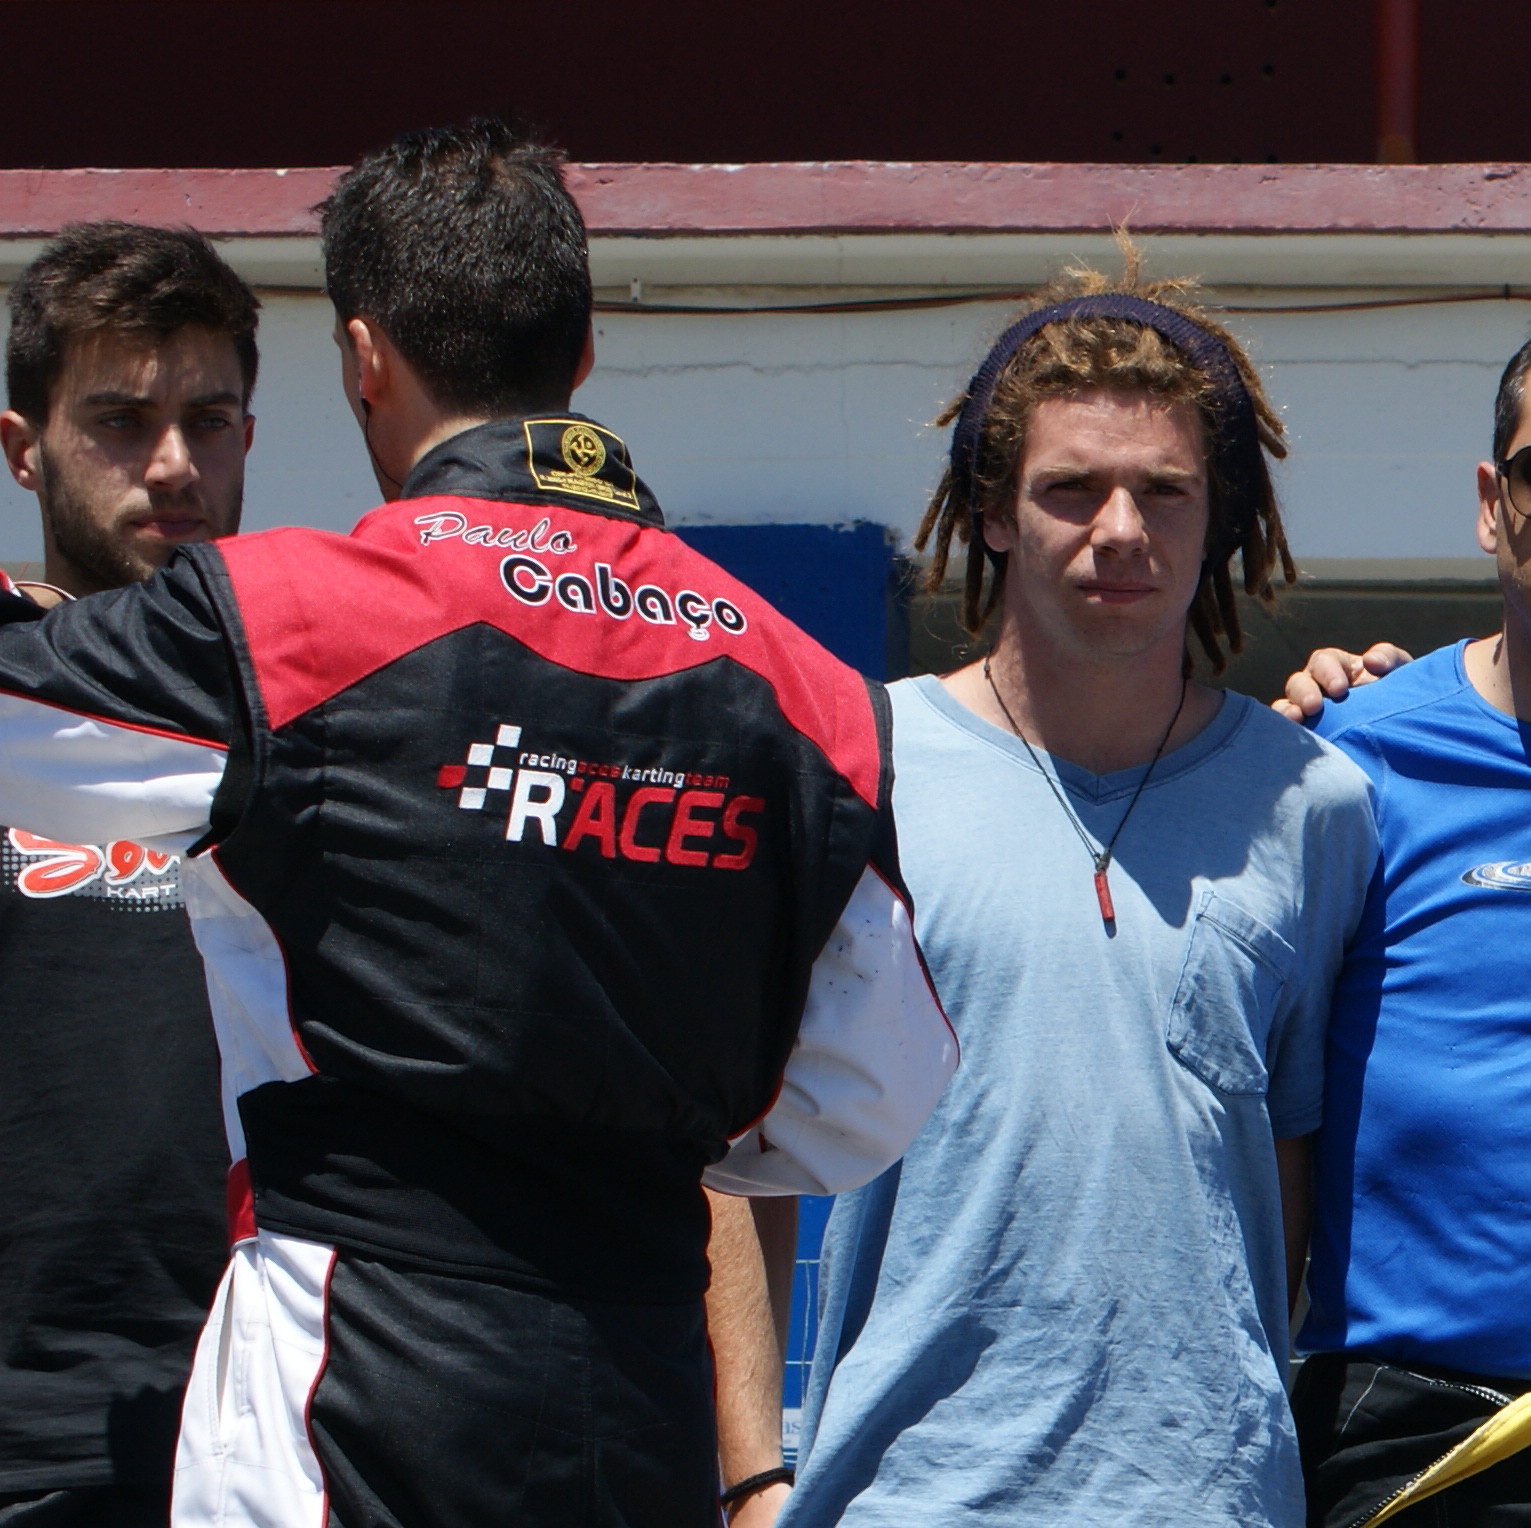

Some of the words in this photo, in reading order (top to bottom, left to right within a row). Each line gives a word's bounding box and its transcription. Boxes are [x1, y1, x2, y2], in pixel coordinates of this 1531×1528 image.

[415, 510, 577, 554] Paulo
[500, 554, 748, 641] Cabaço
[107, 884, 176, 899] KART
